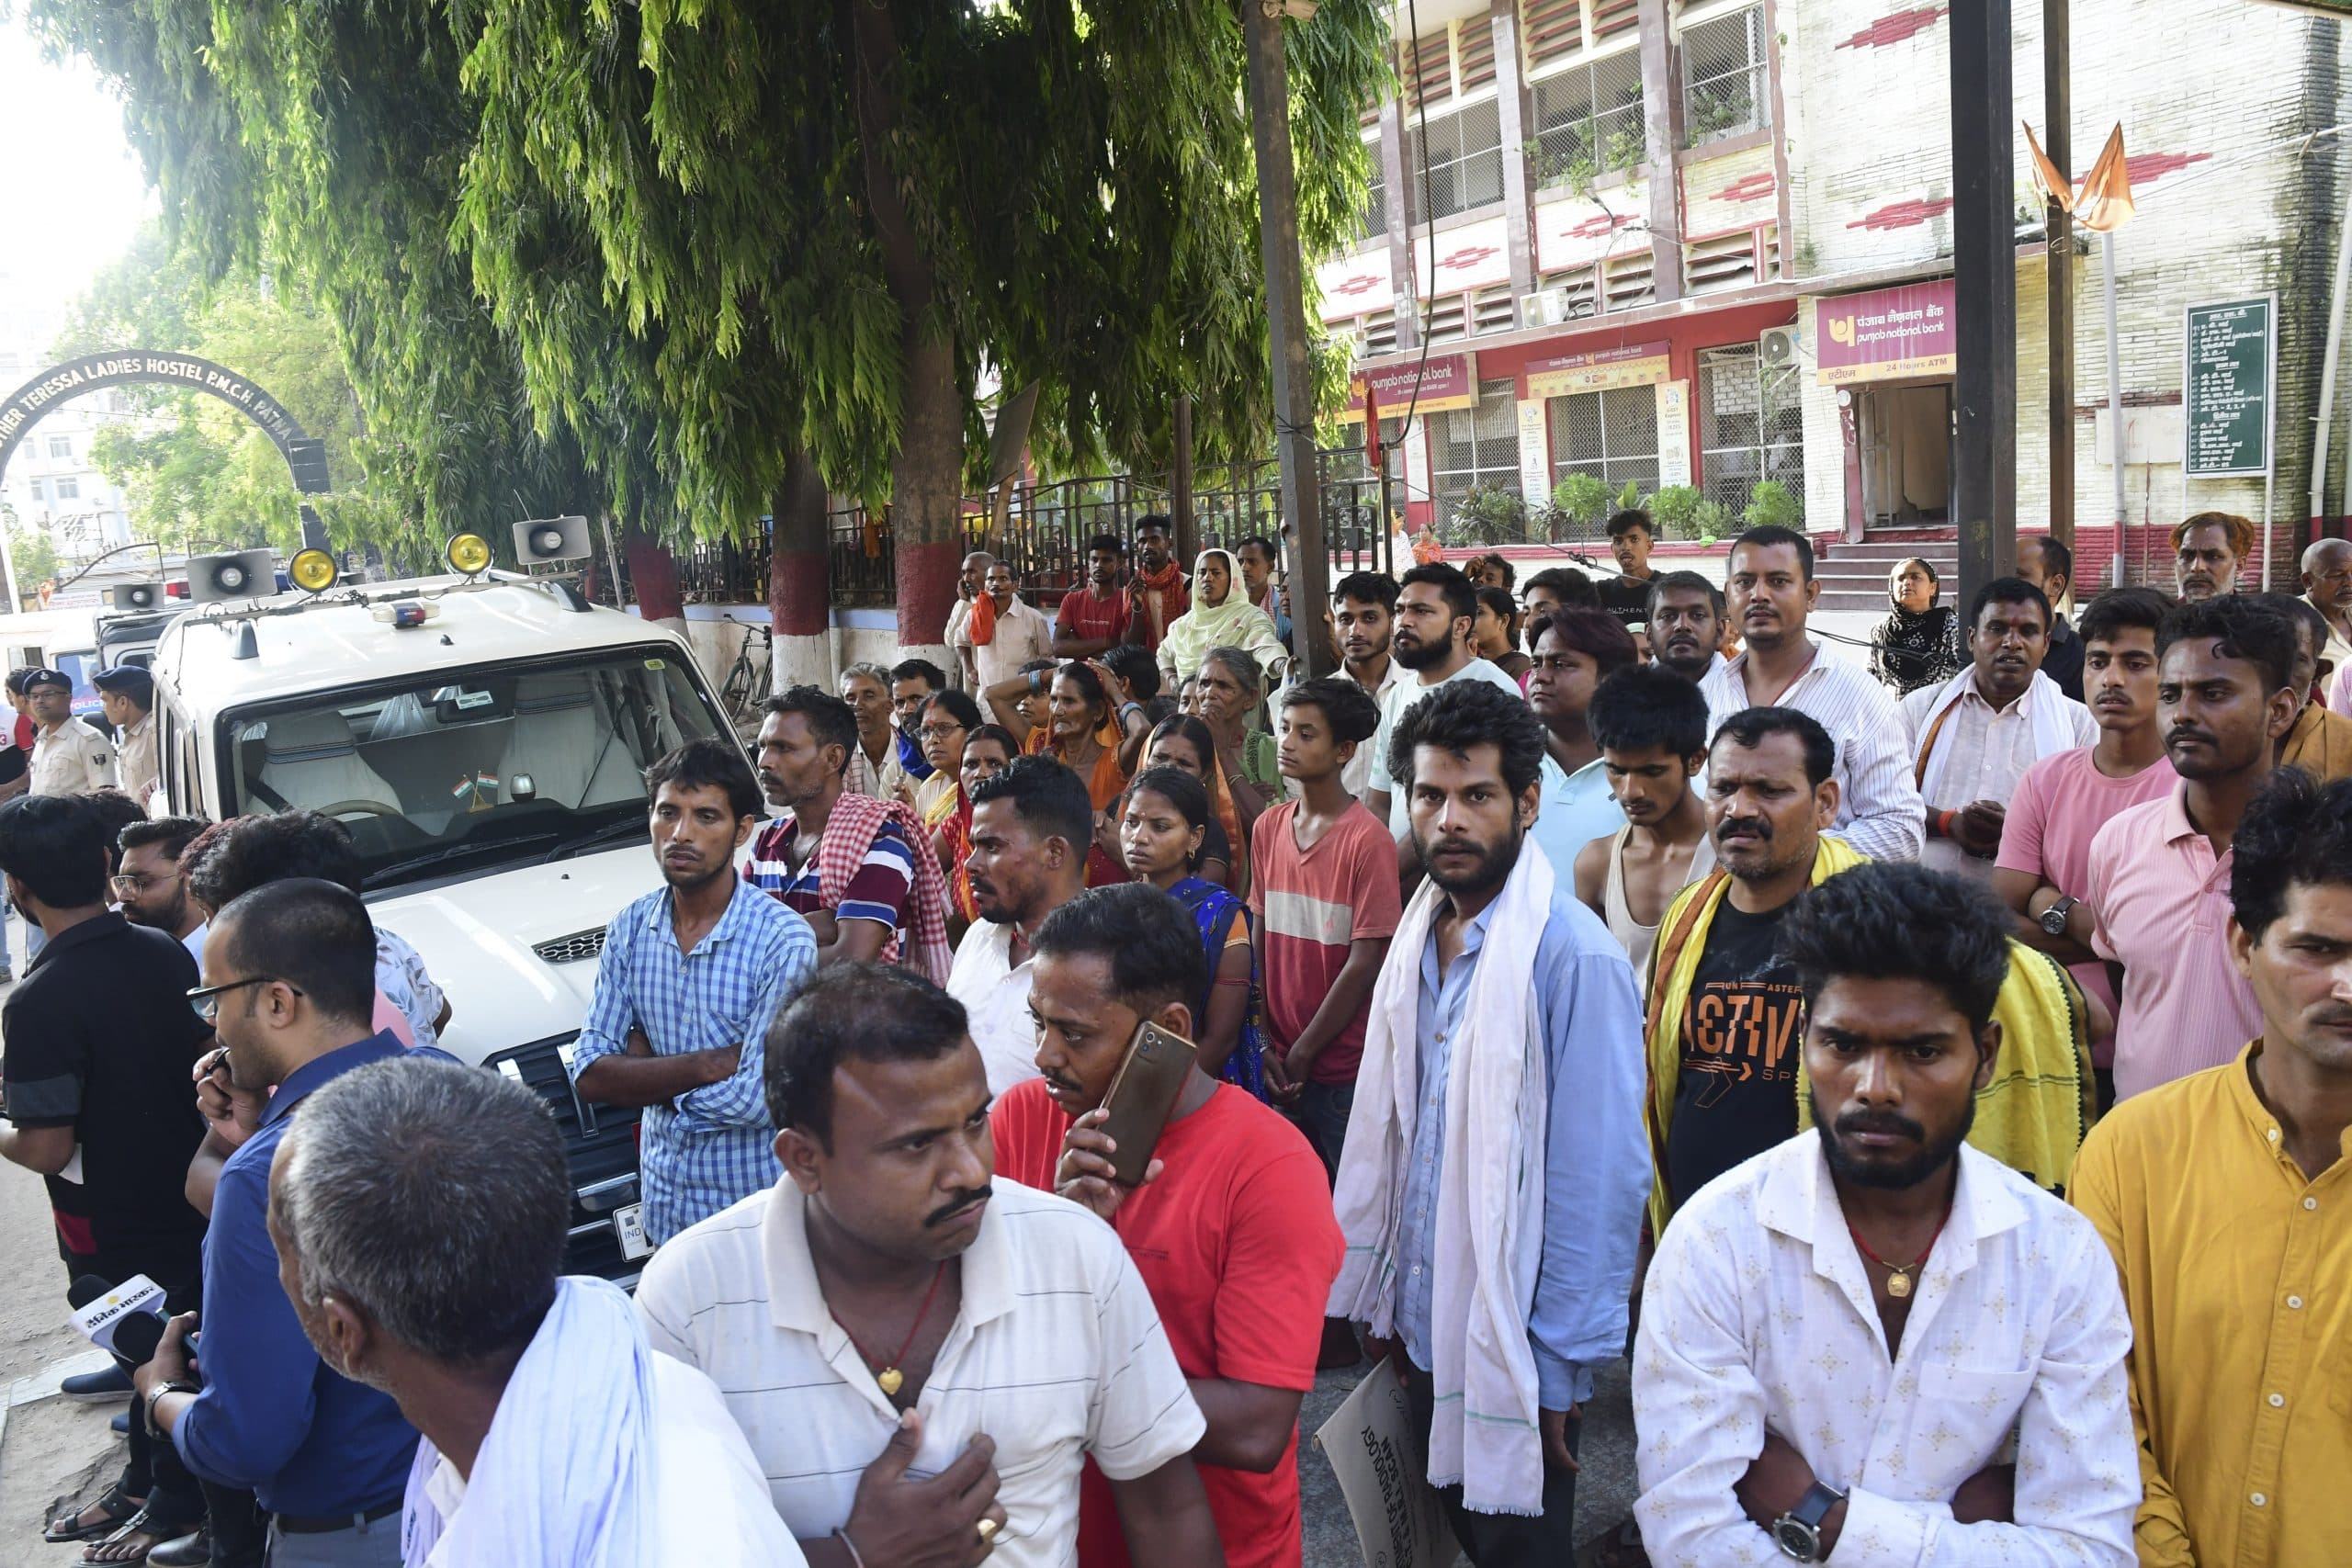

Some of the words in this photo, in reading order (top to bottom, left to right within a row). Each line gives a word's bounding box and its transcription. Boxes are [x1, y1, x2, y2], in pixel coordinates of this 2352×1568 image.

[1857, 329, 1886, 345] punjab
[1886, 325, 1922, 339] national
[1922, 322, 1944, 334] bank
[1397, 368, 1431, 385] natioal
[1431, 364, 1452, 379] bank
[1886, 363, 1897, 372] 24
[1928, 358, 1948, 367] ATM
[19, 369, 85, 412] TERESSA
[84, 357, 142, 380] LADIES
[146, 358, 203, 381] HOSTEL
[253, 397, 293, 441] PATNA
[625, 1227, 641, 1239] IND
[1361, 1425, 1395, 1504] RADIOLOGY
[1380, 1436, 1399, 1484] SCAN
